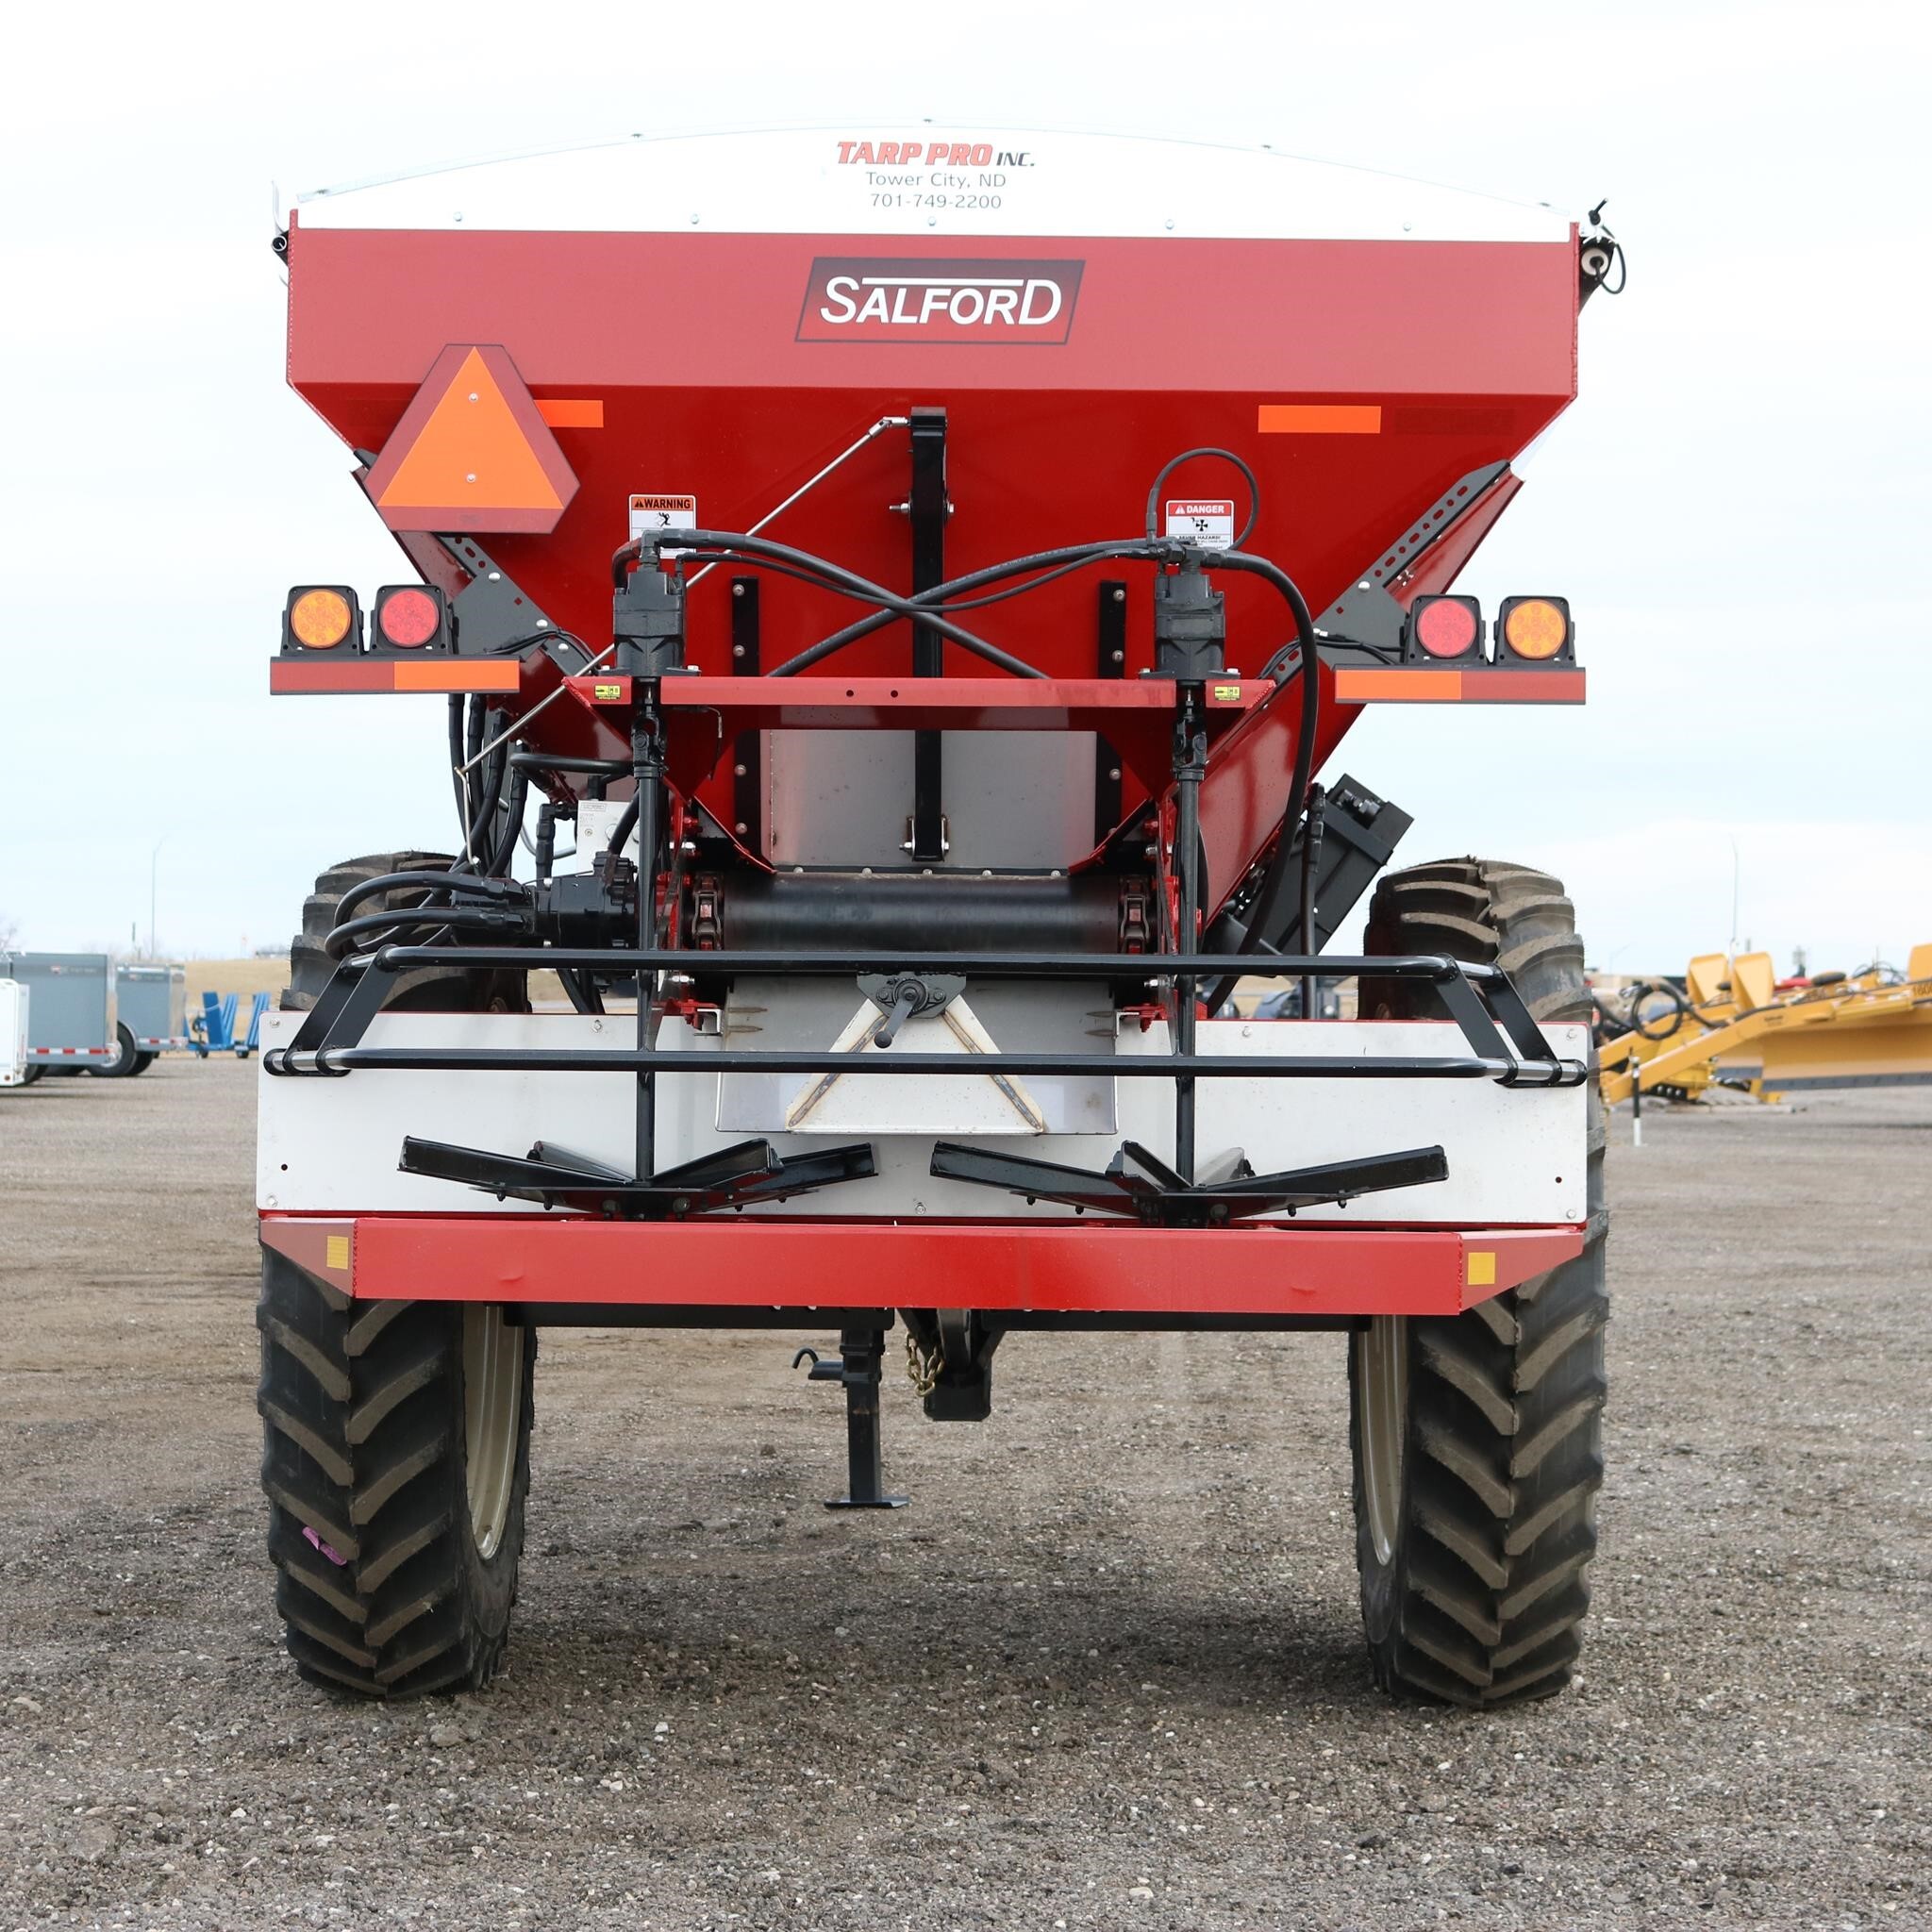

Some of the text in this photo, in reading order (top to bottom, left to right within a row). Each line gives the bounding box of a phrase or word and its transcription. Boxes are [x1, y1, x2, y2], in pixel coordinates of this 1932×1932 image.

[838, 142, 1035, 167] TARP PRO INC.
[865, 172, 1007, 189] Tower City, ND
[870, 193, 1002, 208] 701-749-2200
[820, 275, 1062, 325] SALFORD
[644, 498, 691, 509] WARNING
[1186, 505, 1224, 514] DANGER
